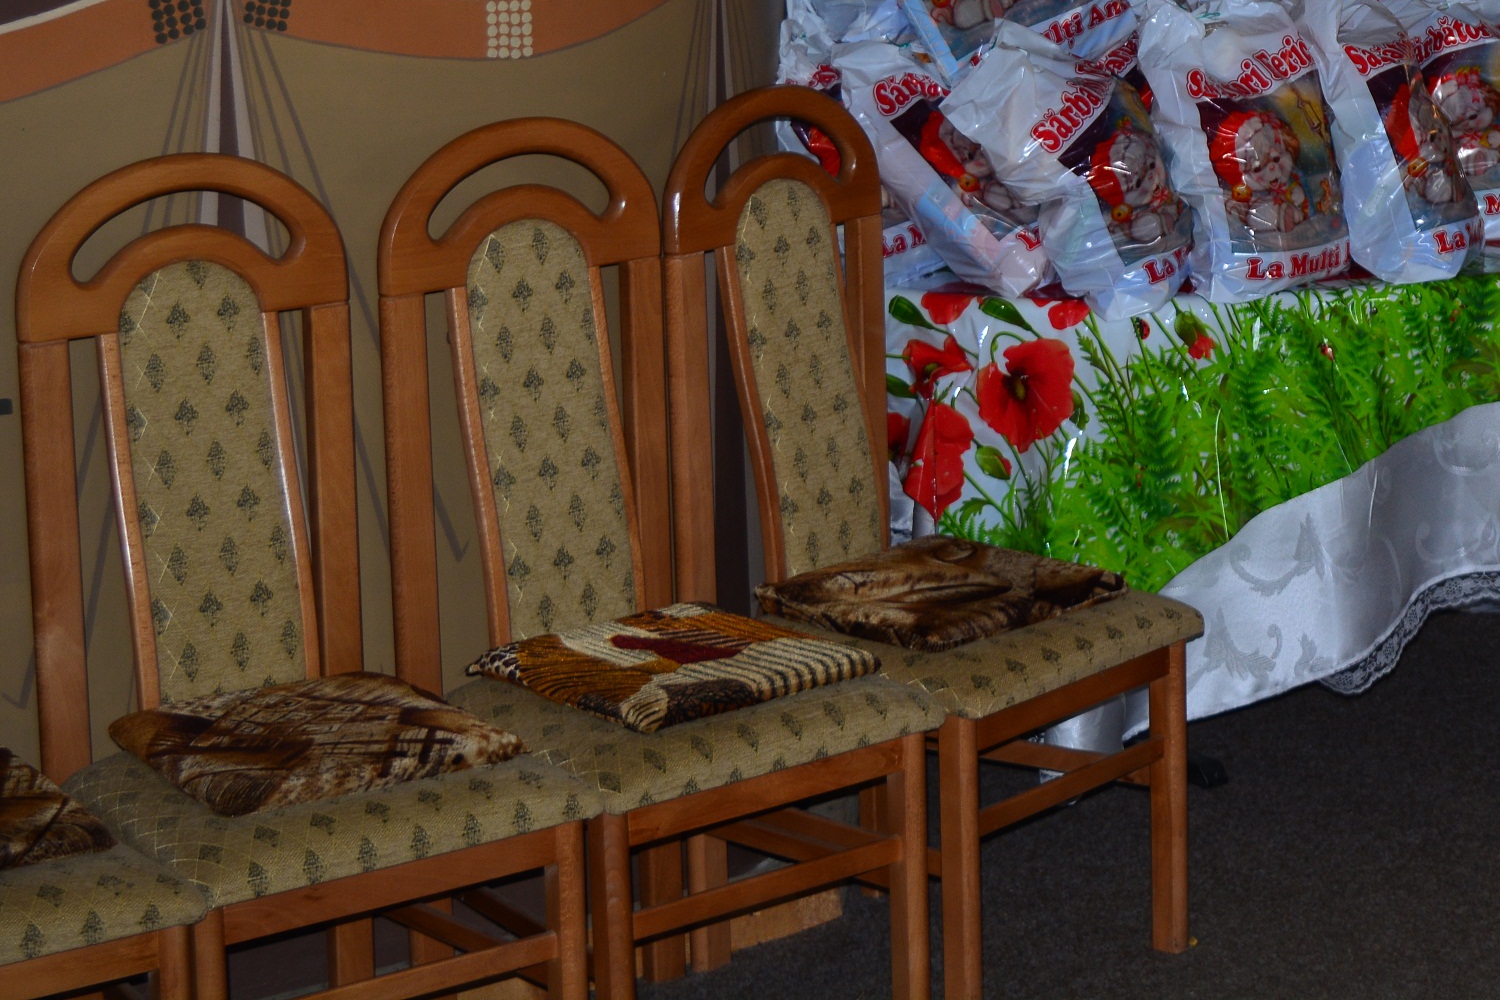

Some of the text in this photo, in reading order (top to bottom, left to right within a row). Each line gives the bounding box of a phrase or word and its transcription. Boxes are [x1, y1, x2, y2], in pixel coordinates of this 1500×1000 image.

[1433, 228, 1466, 254] La
[1142, 258, 1176, 285] La
[1245, 256, 1286, 280] La
[1288, 245, 1341, 279] Mulți
